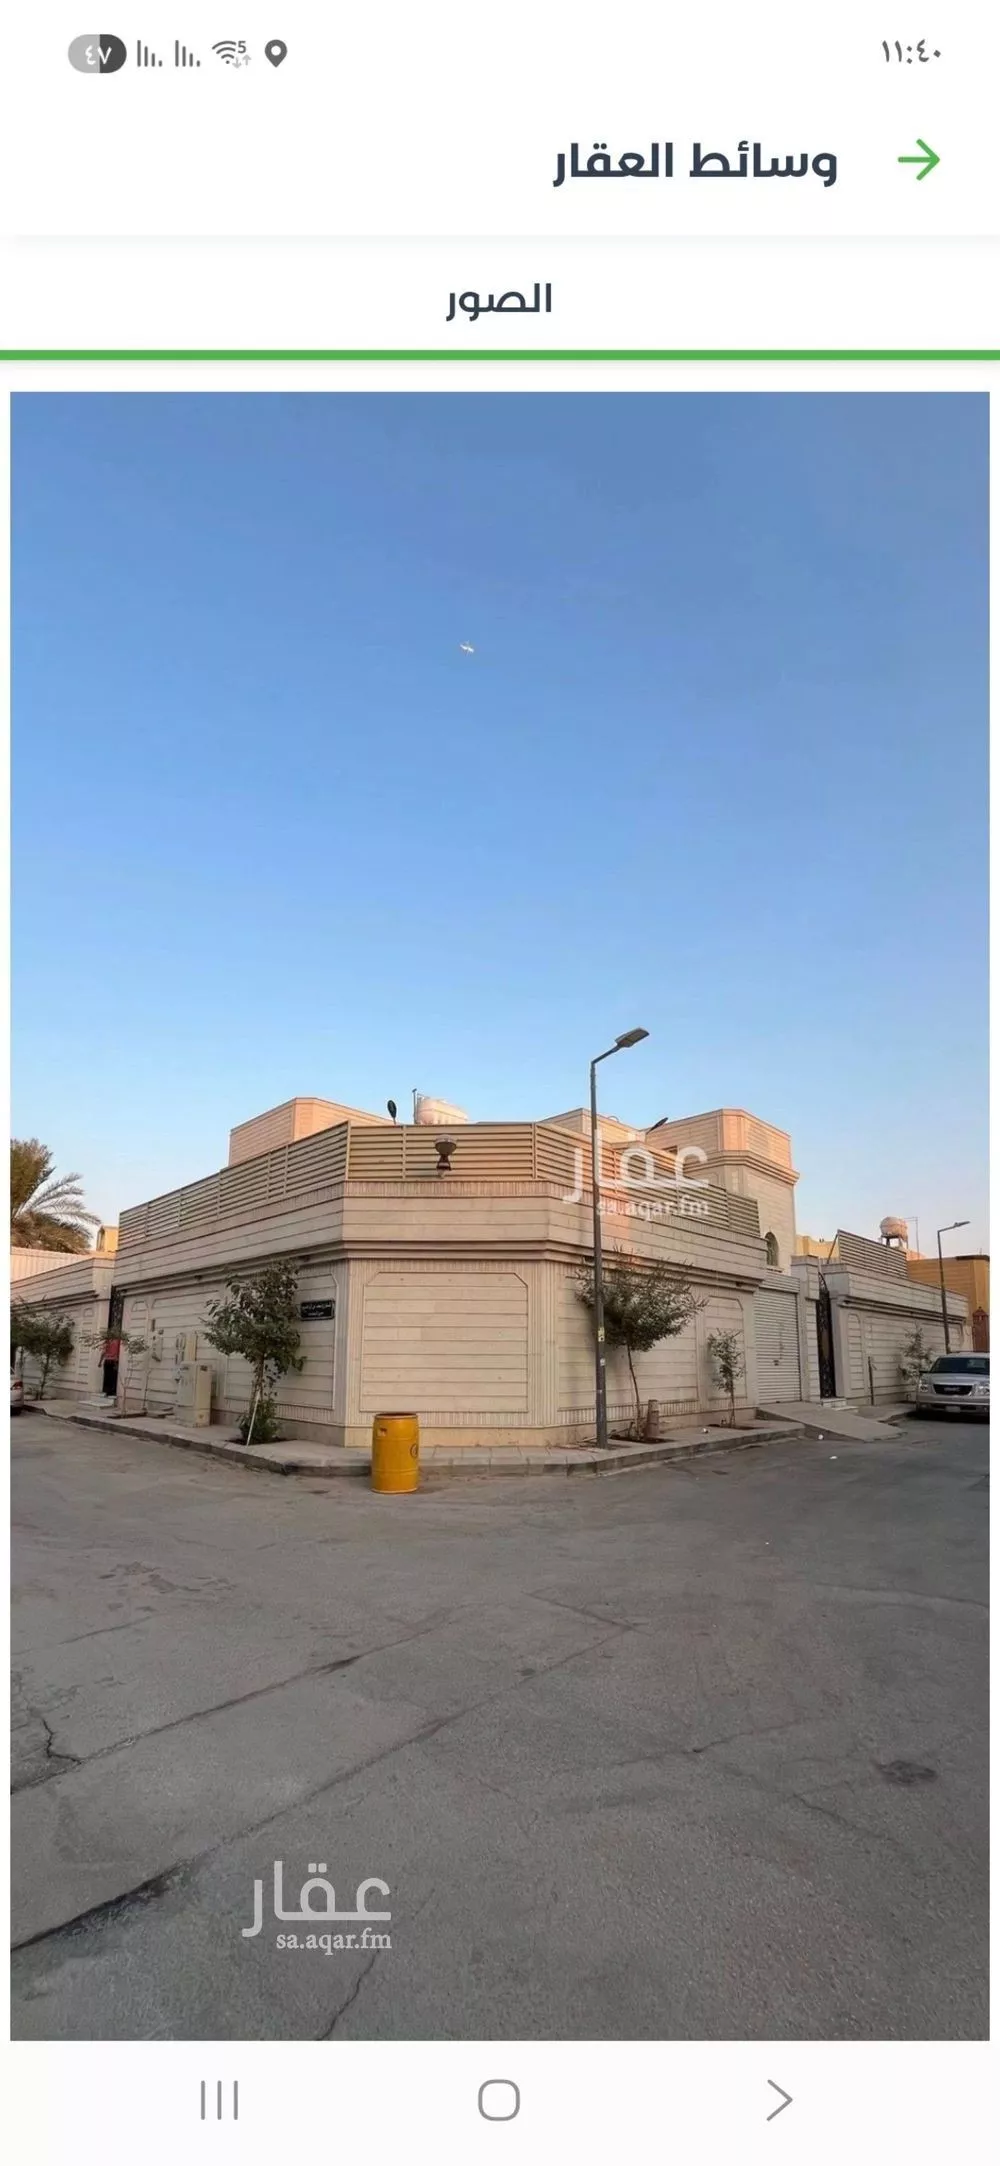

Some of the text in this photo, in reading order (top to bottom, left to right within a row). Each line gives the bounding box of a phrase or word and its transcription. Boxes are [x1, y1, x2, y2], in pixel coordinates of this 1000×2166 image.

[85, 44, 112, 65] ٤٧
[882, 39, 942, 65] ١١:٤٠
[553, 141, 838, 188] وسائط العقار
[445, 282, 552, 322] الصور
